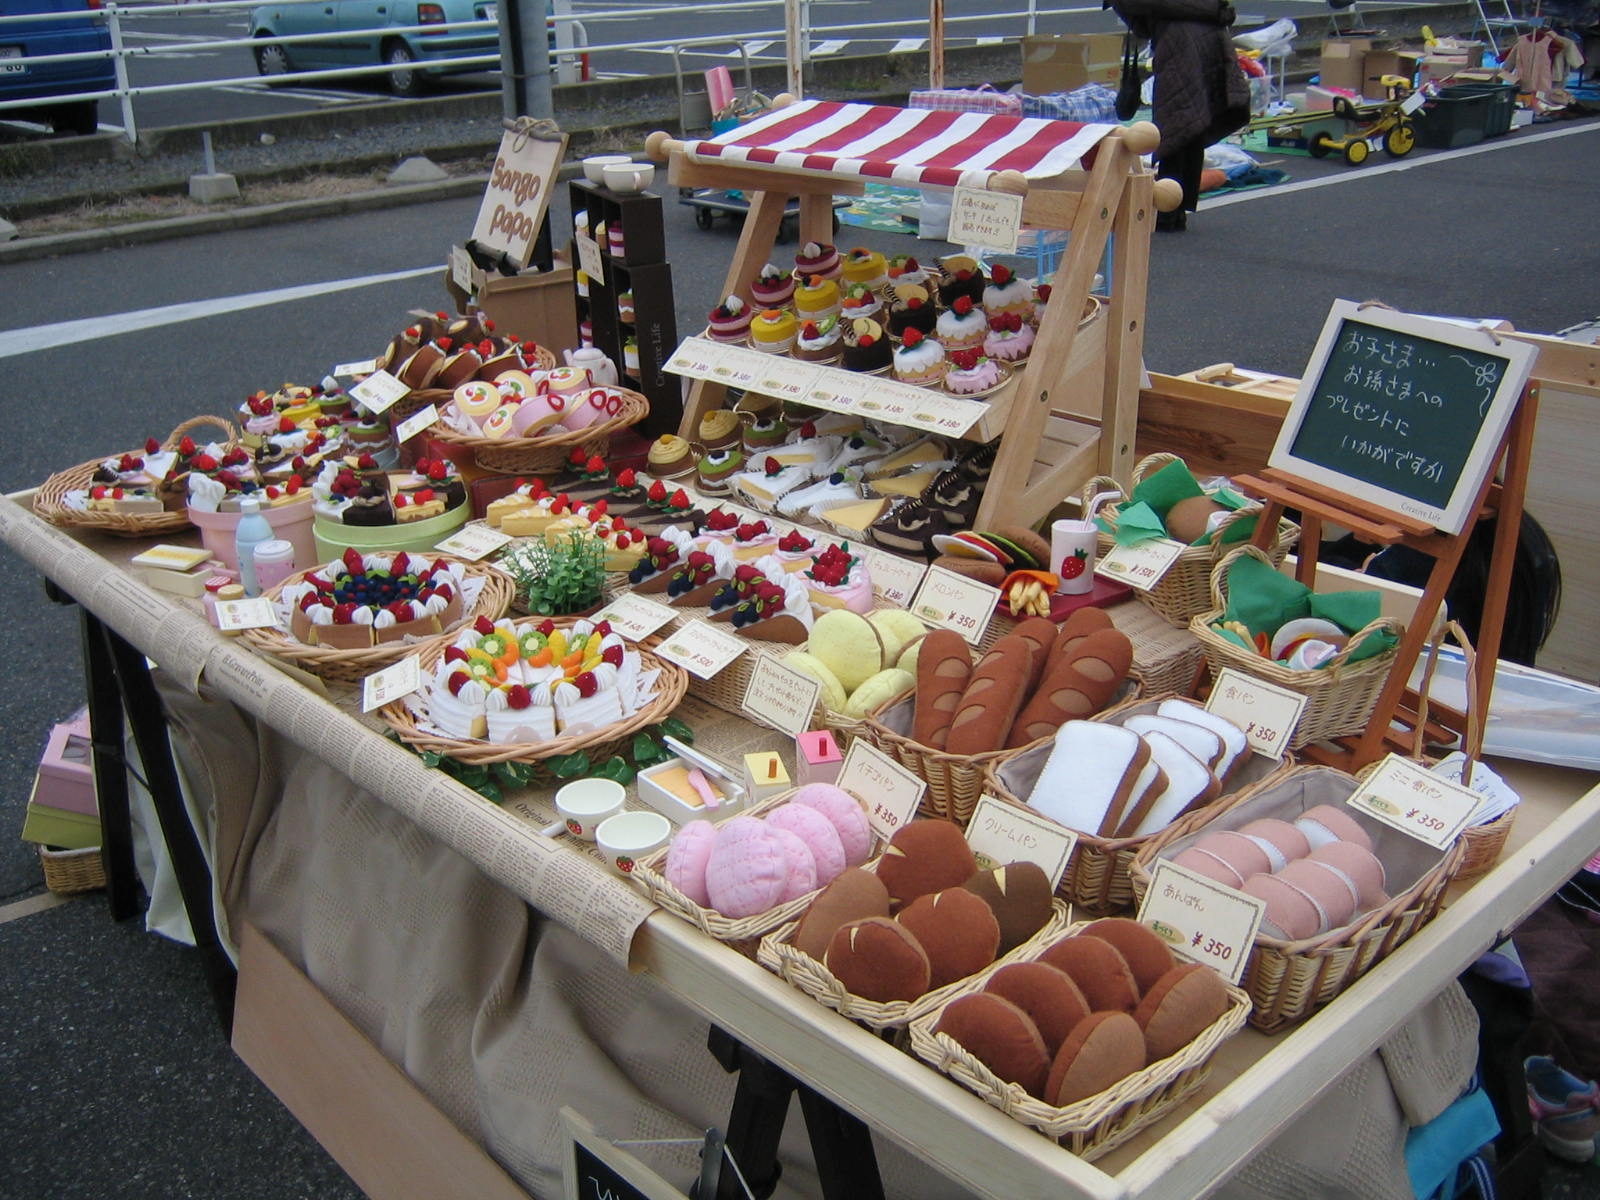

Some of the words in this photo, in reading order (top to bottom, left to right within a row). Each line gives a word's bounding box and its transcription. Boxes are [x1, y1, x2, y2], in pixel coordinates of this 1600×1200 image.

[490, 157, 542, 208] Sango
[488, 203, 534, 245] papa
[1342, 364, 1444, 409] お孫さまへの
[1325, 393, 1411, 437] プレゼントに
[1340, 434, 1445, 485] いかがですか
[1400, 501, 1428, 520] Creative
[1426, 509, 1442, 524] Life
[1224, 685, 1256, 705] 食パン
[1245, 720, 1277, 742] ¥350
[856, 759, 896, 793] イチゴパン
[873, 803, 898, 827] ¥350
[1405, 807, 1446, 832] ¥350
[983, 816, 1039, 850] クリームパン
[1190, 930, 1233, 961] ¥350
